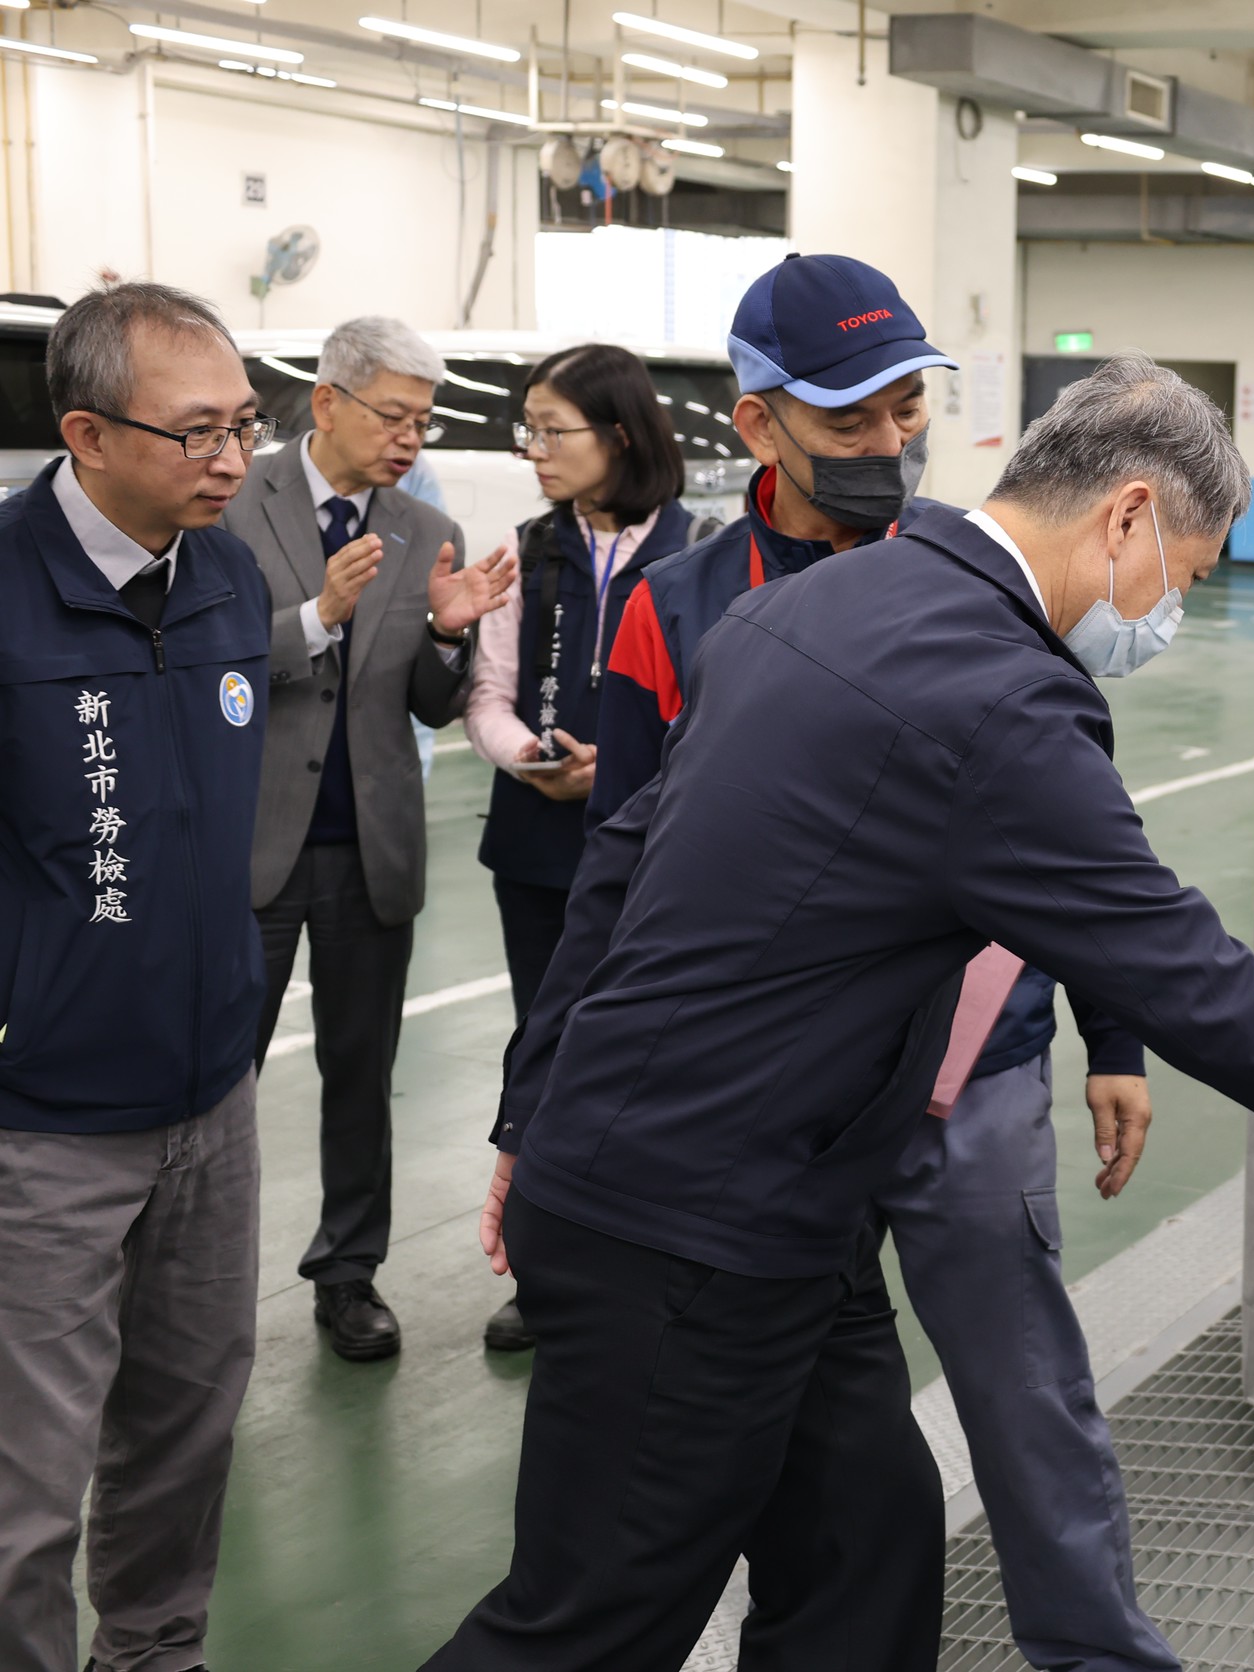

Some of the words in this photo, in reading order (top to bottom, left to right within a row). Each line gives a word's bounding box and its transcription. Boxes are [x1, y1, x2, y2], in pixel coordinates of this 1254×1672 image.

[836, 308, 894, 332] TOYOTA
[73, 690, 133, 923] 新北市勞檢處
